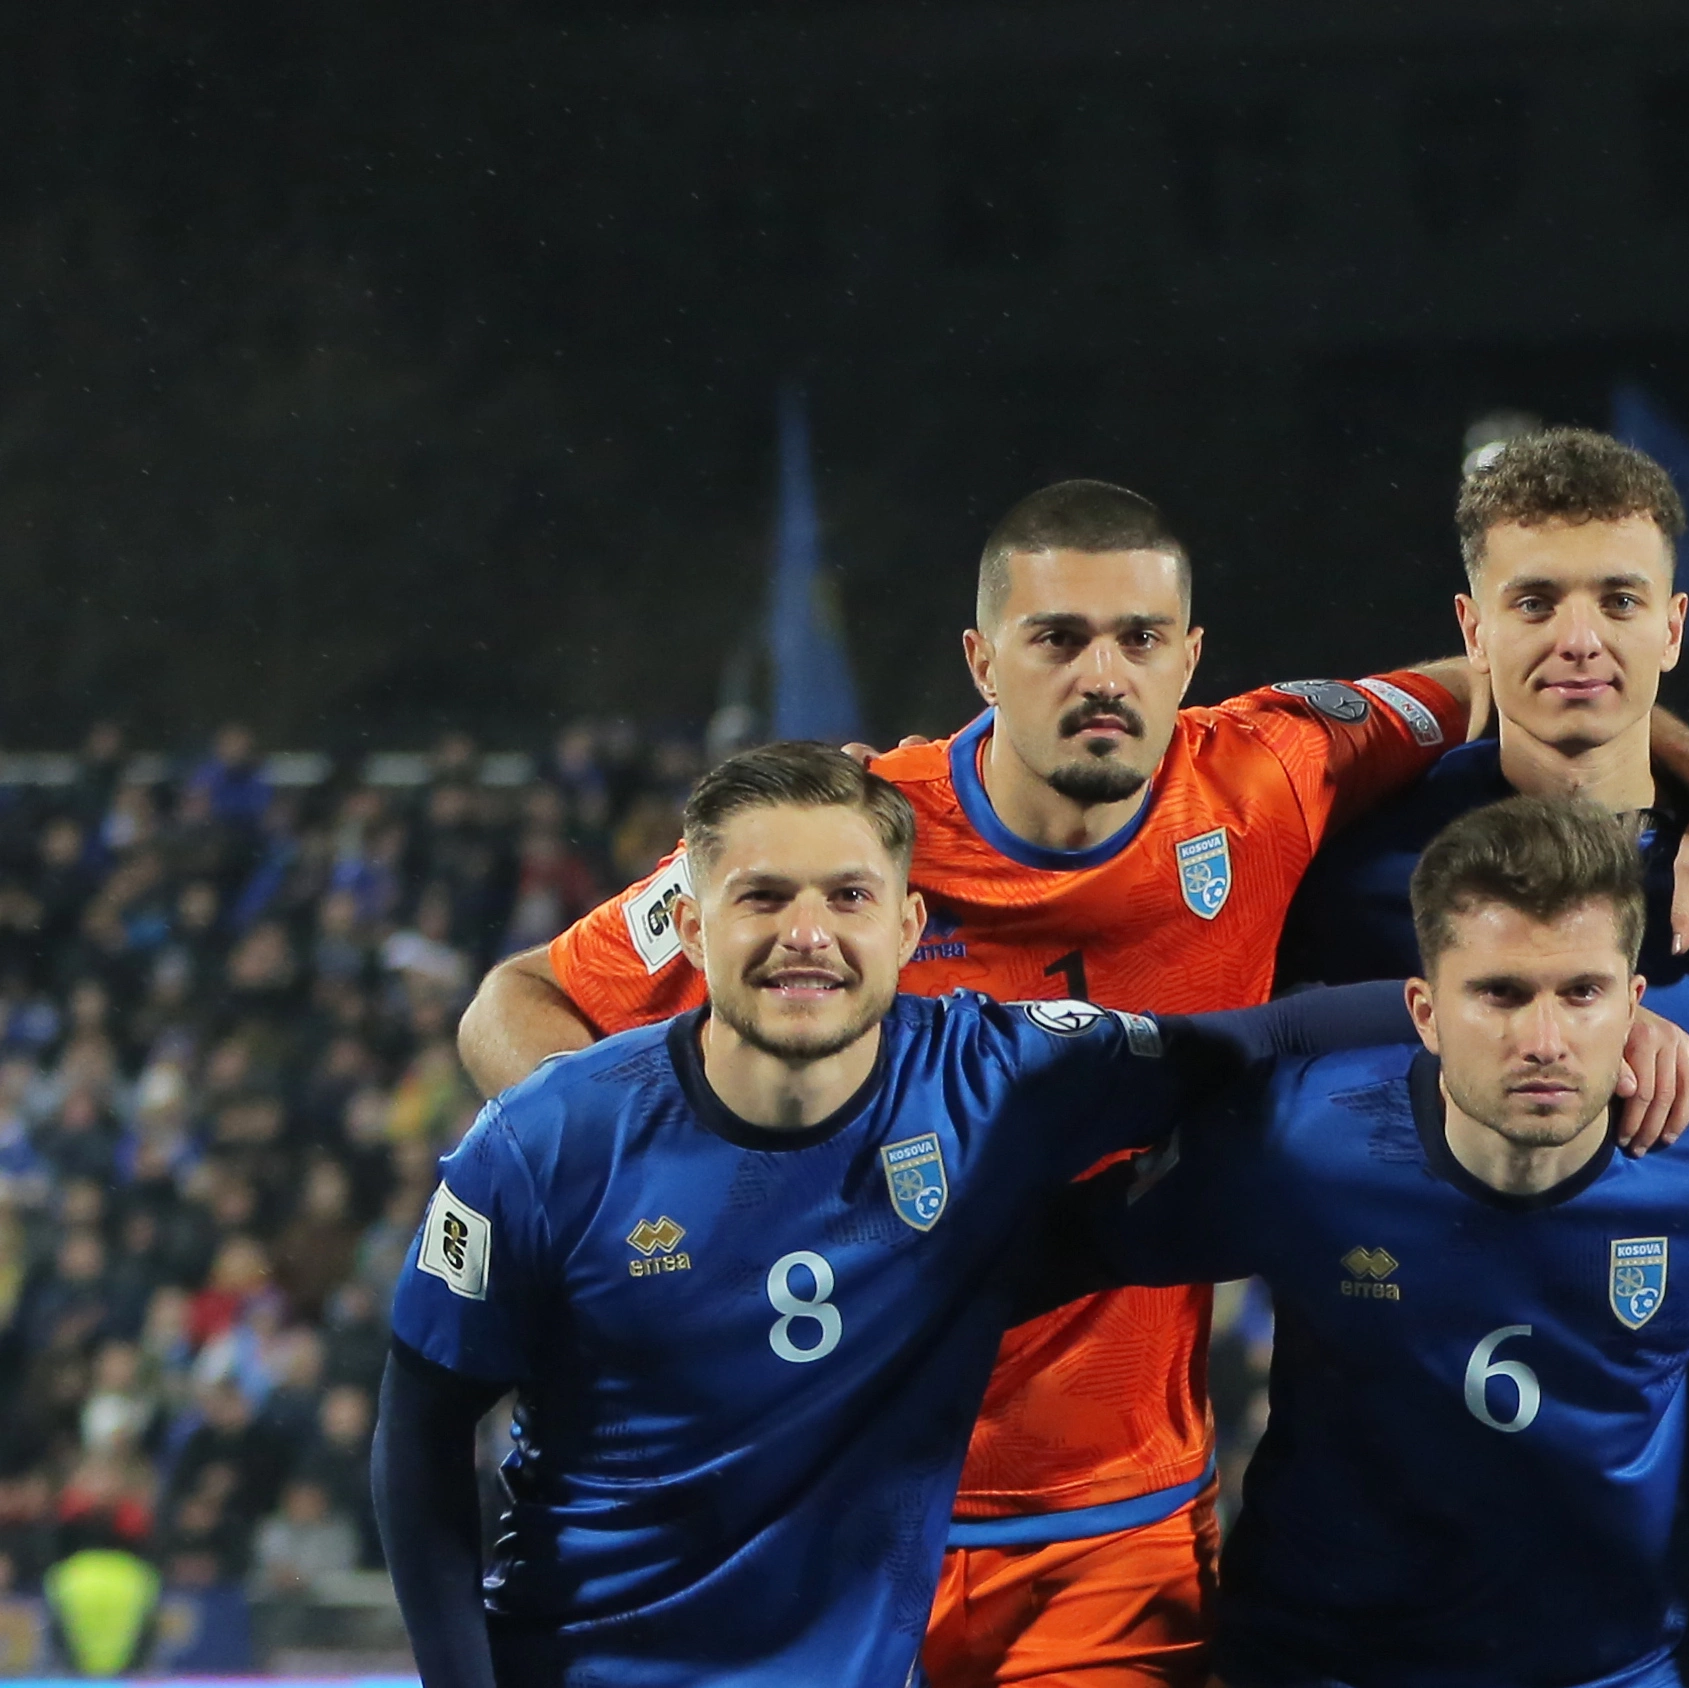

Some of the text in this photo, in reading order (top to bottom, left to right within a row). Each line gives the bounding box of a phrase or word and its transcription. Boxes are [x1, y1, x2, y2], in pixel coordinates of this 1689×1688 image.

[1181, 837, 1221, 858] KOSOVA
[889, 1141, 934, 1162] KOSOVA
[1617, 1244, 1661, 1257] KOSOVA
[767, 1250, 843, 1363] 8
[1464, 1324, 1541, 1433] 6
